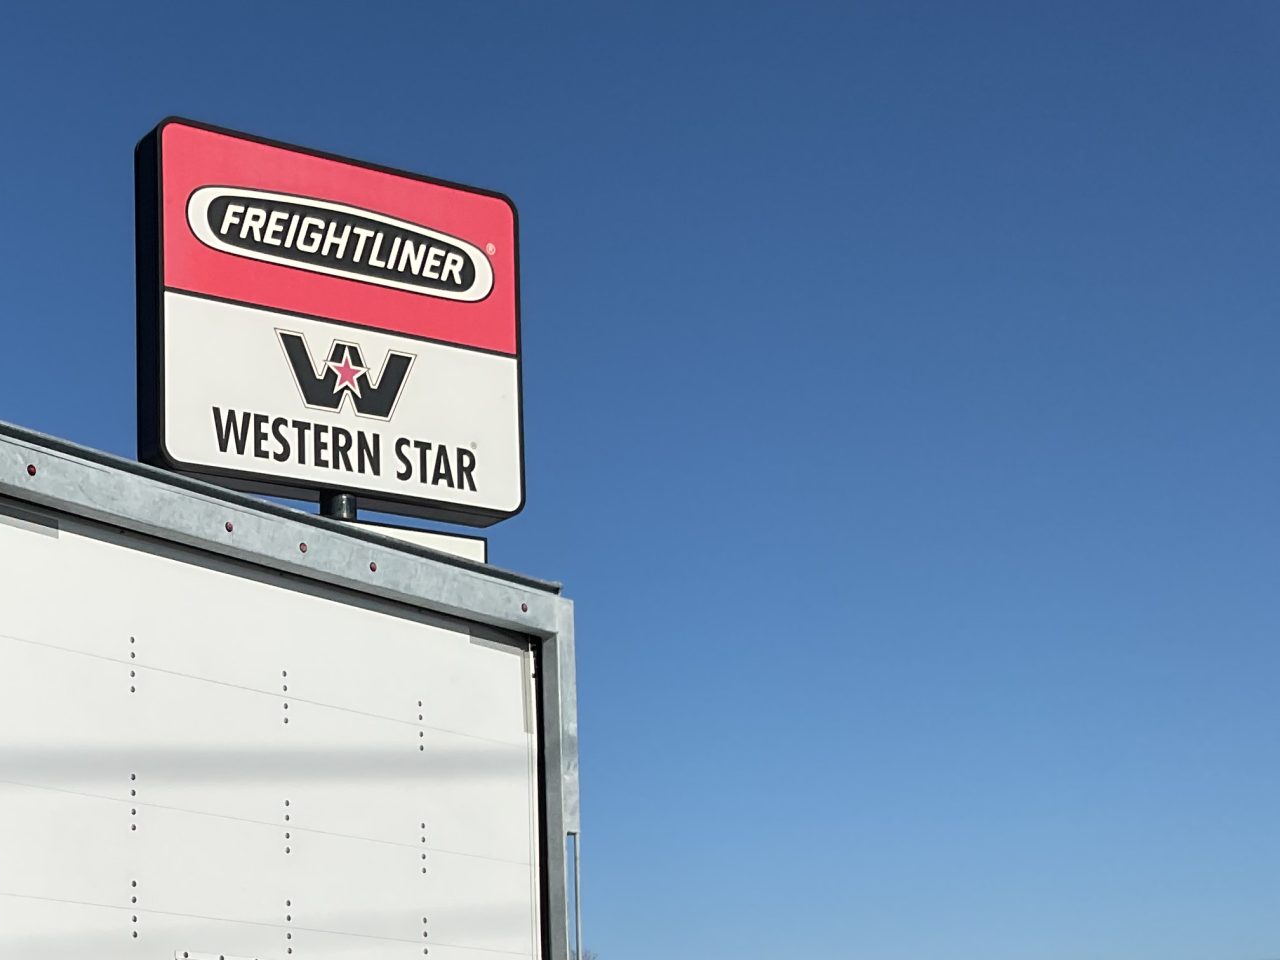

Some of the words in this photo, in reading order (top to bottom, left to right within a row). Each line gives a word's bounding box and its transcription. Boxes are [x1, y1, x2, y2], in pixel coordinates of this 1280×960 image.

[220, 201, 465, 285] FREIGHTLINER
[212, 406, 381, 476] WESTERN
[395, 437, 477, 492] STAR
